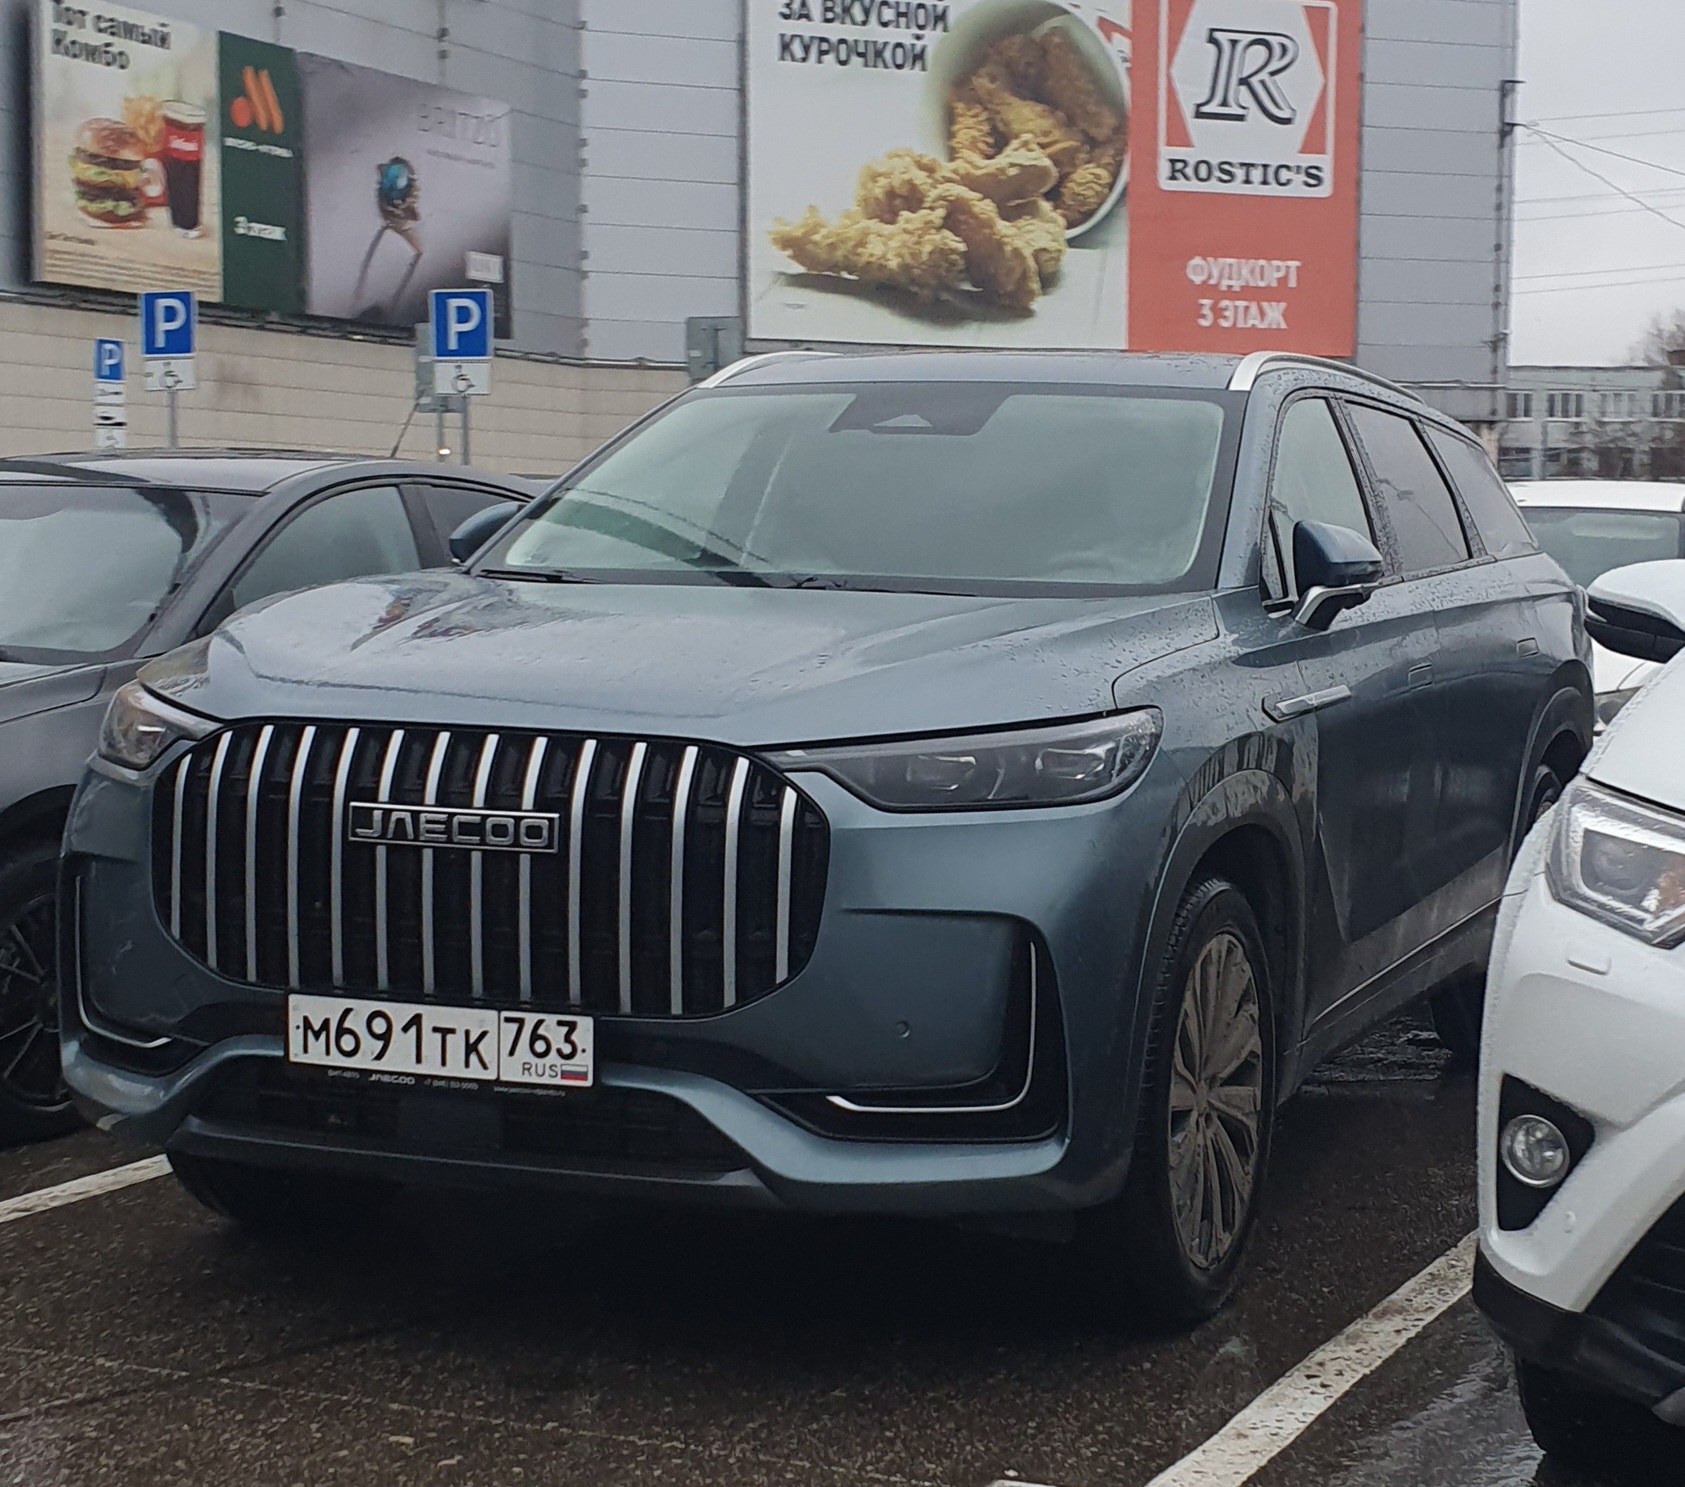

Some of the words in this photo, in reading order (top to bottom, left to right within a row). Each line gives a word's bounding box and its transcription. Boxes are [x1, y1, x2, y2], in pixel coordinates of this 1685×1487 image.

[92, 14, 171, 50] самый
[779, 0, 815, 22] ЗА
[823, 0, 949, 33] ВКУСНОЙ
[51, 28, 131, 70] Комбо
[778, 33, 928, 72] КУРОЧКОЙ
[1195, 28, 1300, 125] R
[1166, 158, 1325, 188] ROSTIC'S
[1185, 256, 1302, 291] ФУДКОРТ
[154, 298, 187, 348] P
[445, 298, 482, 350] P
[1197, 299, 1214, 327] 3
[1217, 300, 1288, 329] ЭТАЖ
[355, 809, 549, 847] JAECOO
[302, 1007, 490, 1071] М691ТК
[503, 1016, 578, 1060] 763
[521, 1062, 558, 1079] RUS
